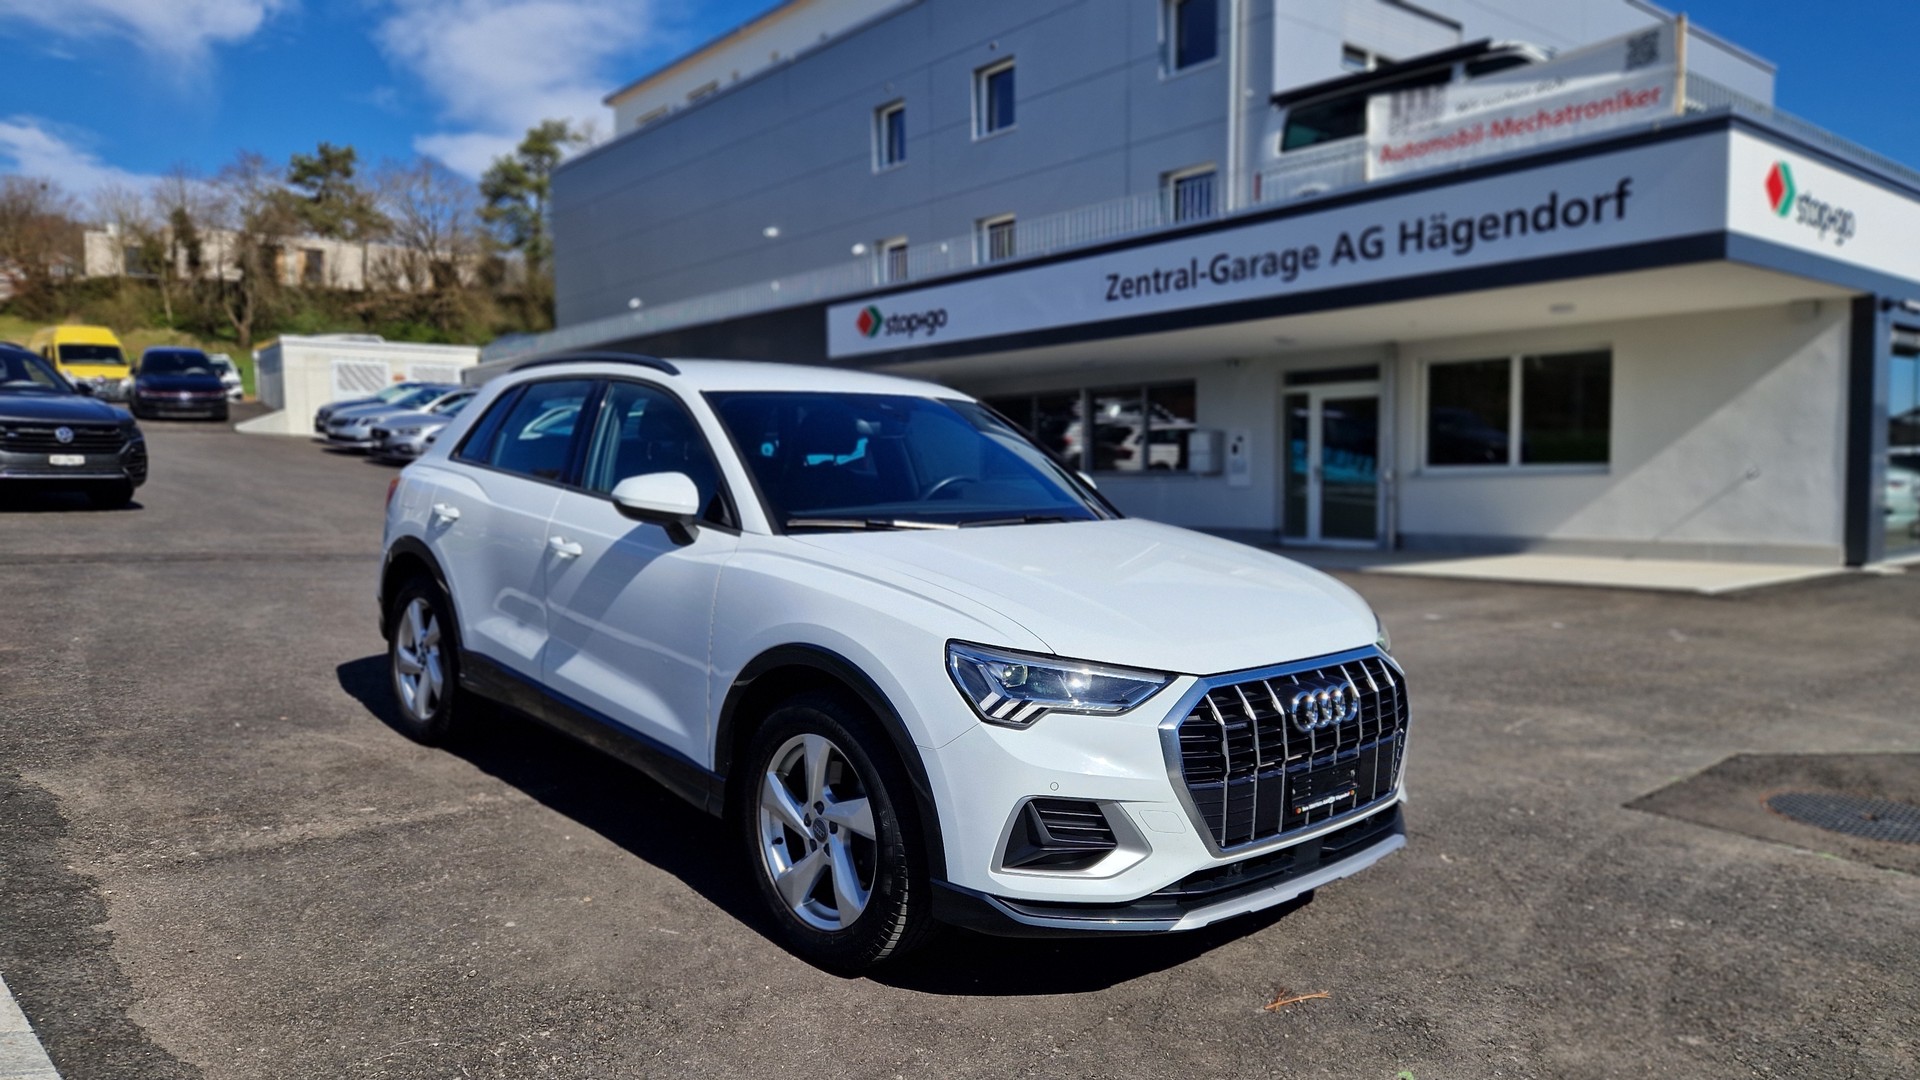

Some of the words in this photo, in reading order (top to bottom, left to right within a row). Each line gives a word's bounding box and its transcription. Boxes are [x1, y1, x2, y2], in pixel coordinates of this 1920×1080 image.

[1380, 85, 1662, 162] Automobil-Mechatroniker
[1105, 245, 1320, 301] Zentral-Garage
[1331, 226, 1384, 264] AG
[1399, 178, 1632, 254] Hägendorf
